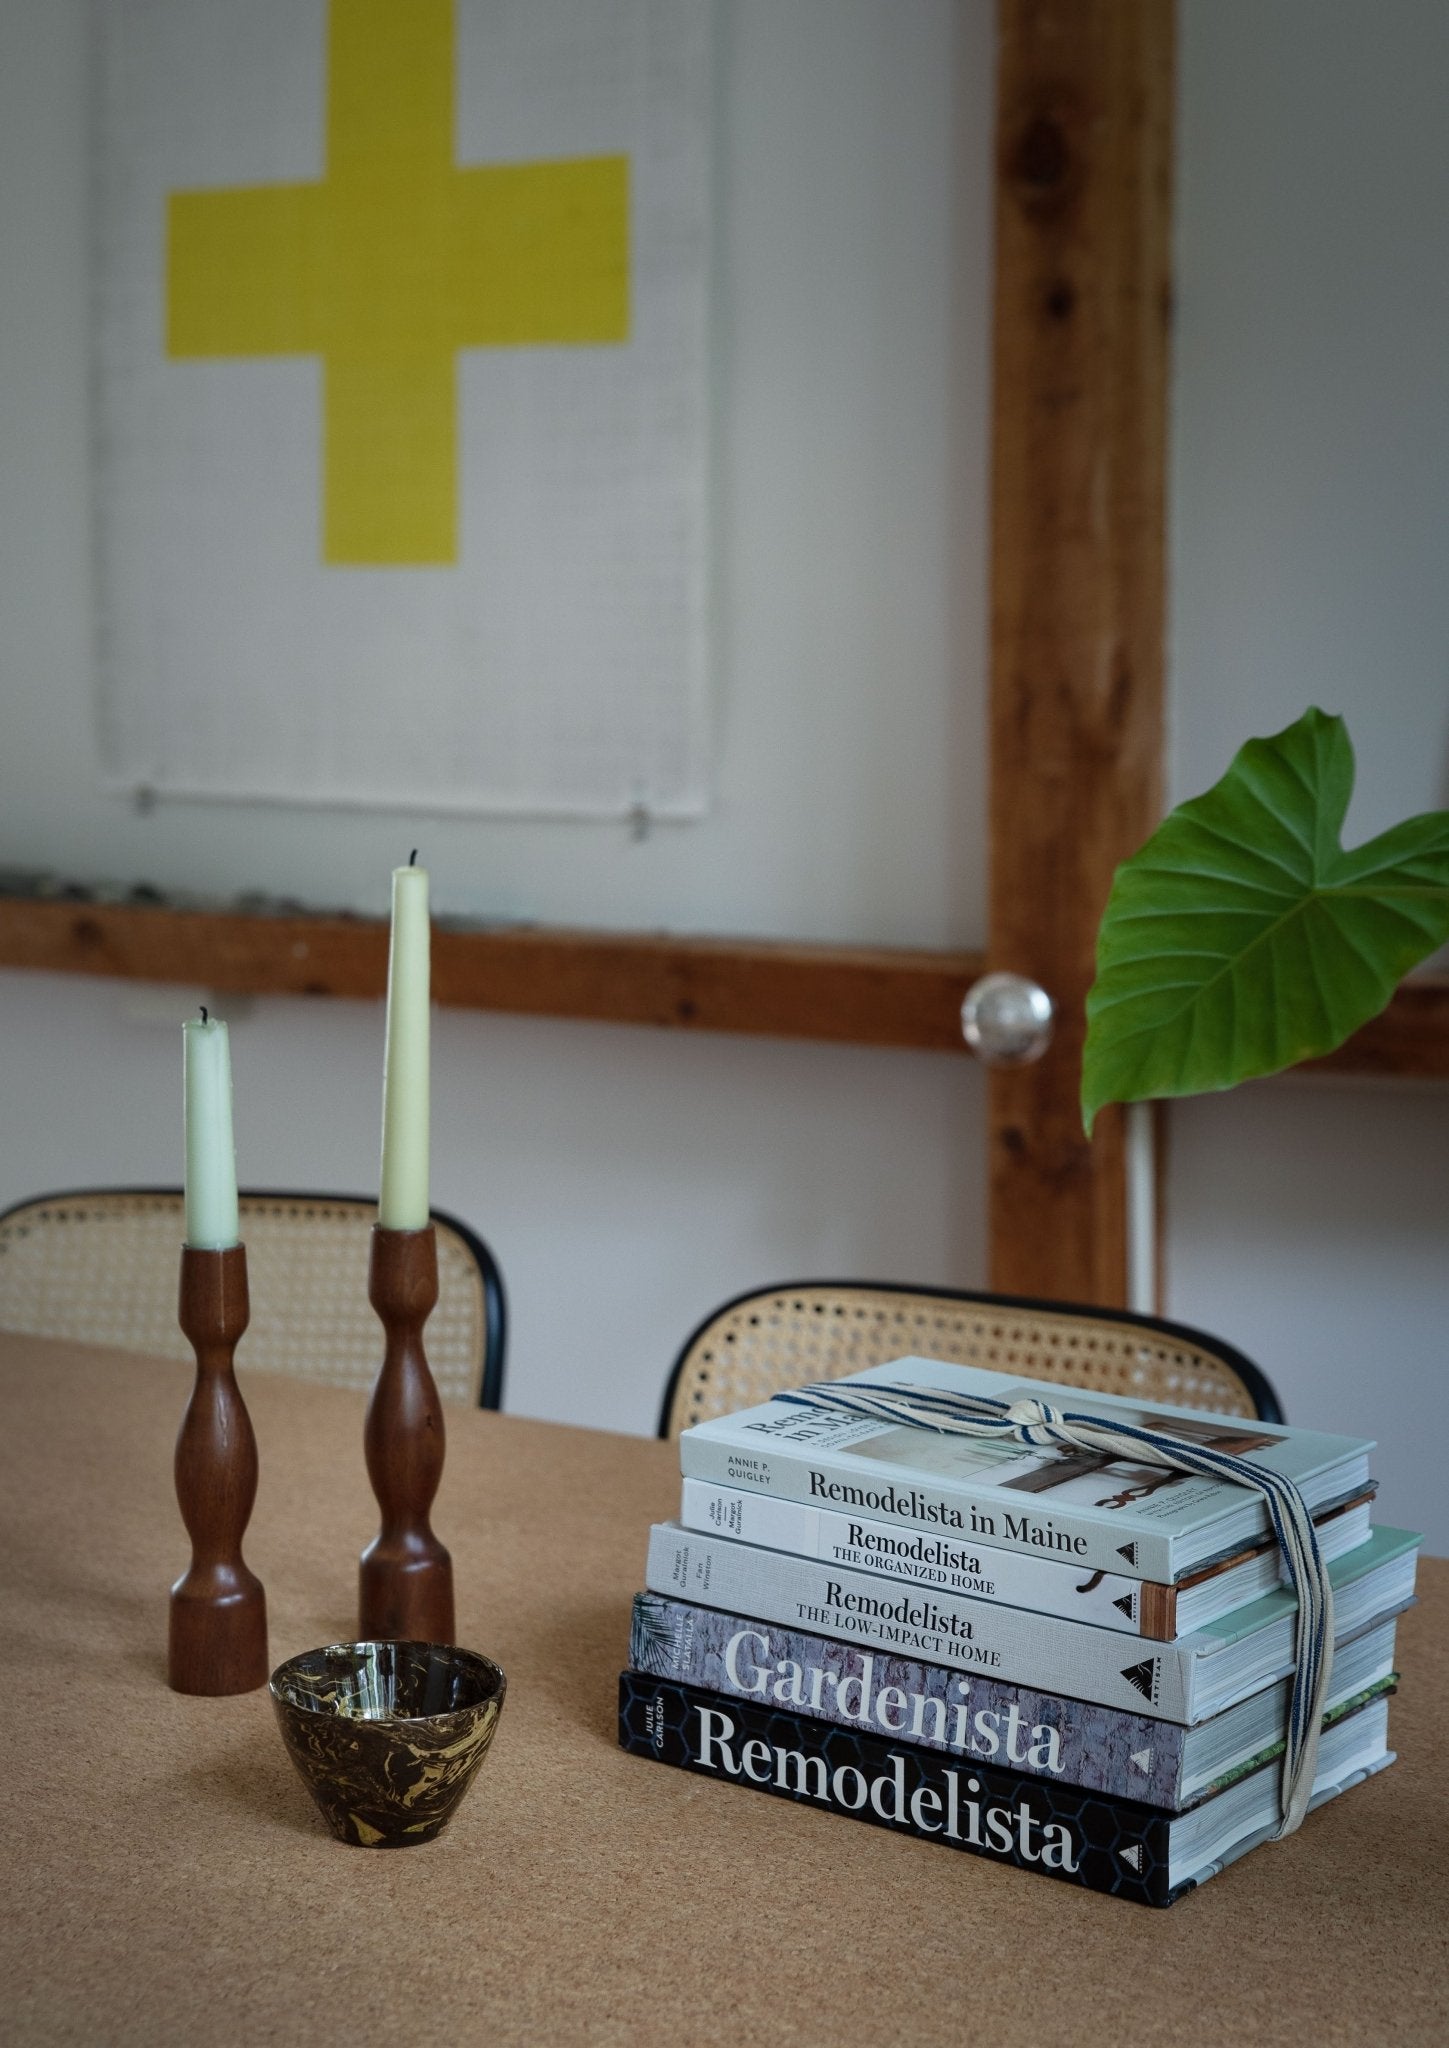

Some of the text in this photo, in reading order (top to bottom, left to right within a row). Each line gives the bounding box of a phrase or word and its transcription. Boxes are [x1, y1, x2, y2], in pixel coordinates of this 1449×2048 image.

[775, 1429, 823, 1441] in
[728, 1456, 770, 1472] ANNIE P.
[728, 1468, 771, 1484] QUIGLEY
[728, 1502, 737, 1528] Margot
[808, 1470, 1088, 1555] Remodelista in Maine
[673, 1550, 682, 1580] Margot
[703, 1555, 712, 1590] Winston
[833, 1545, 995, 1595] THE ORGANIZED HOME
[847, 1523, 982, 1575] Remodelista
[796, 1603, 1001, 1668] THE LOW-IMPACT HOME
[825, 1580, 974, 1640] Remodelista
[672, 1614, 684, 1670] MICHELLE
[682, 1618, 694, 1671] SLATALLA
[725, 1629, 1066, 1774] Gardenista
[1153, 1656, 1162, 1708] ARTISAN
[646, 1704, 654, 1735] JULIE
[656, 1696, 664, 1748] CARLSON
[694, 1705, 1080, 1874] Remodelista
